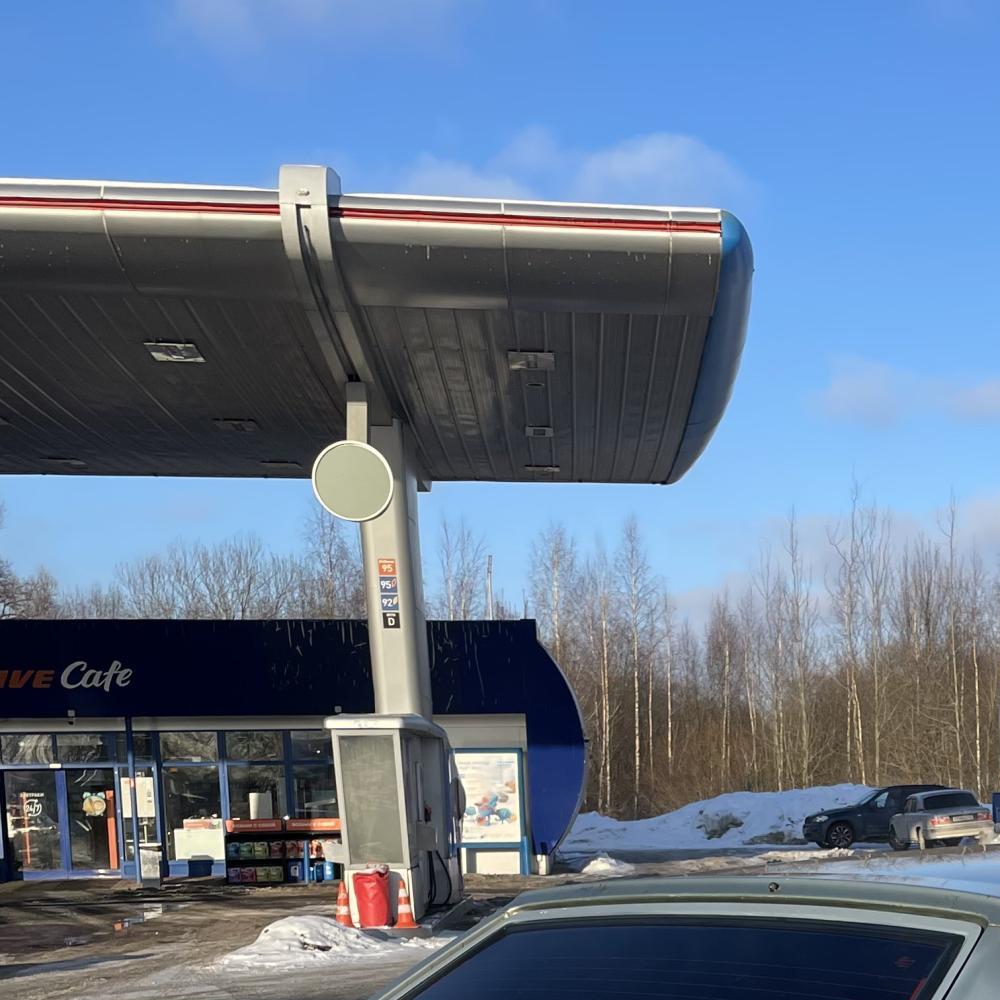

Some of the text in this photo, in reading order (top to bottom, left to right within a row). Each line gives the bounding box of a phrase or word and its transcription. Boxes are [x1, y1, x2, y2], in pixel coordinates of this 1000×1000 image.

[382, 564, 393, 572] 95
[380, 581, 392, 589] 95
[382, 598, 393, 607] 92
[388, 617, 395, 626] D
[60, 660, 133, 692] Cafe
